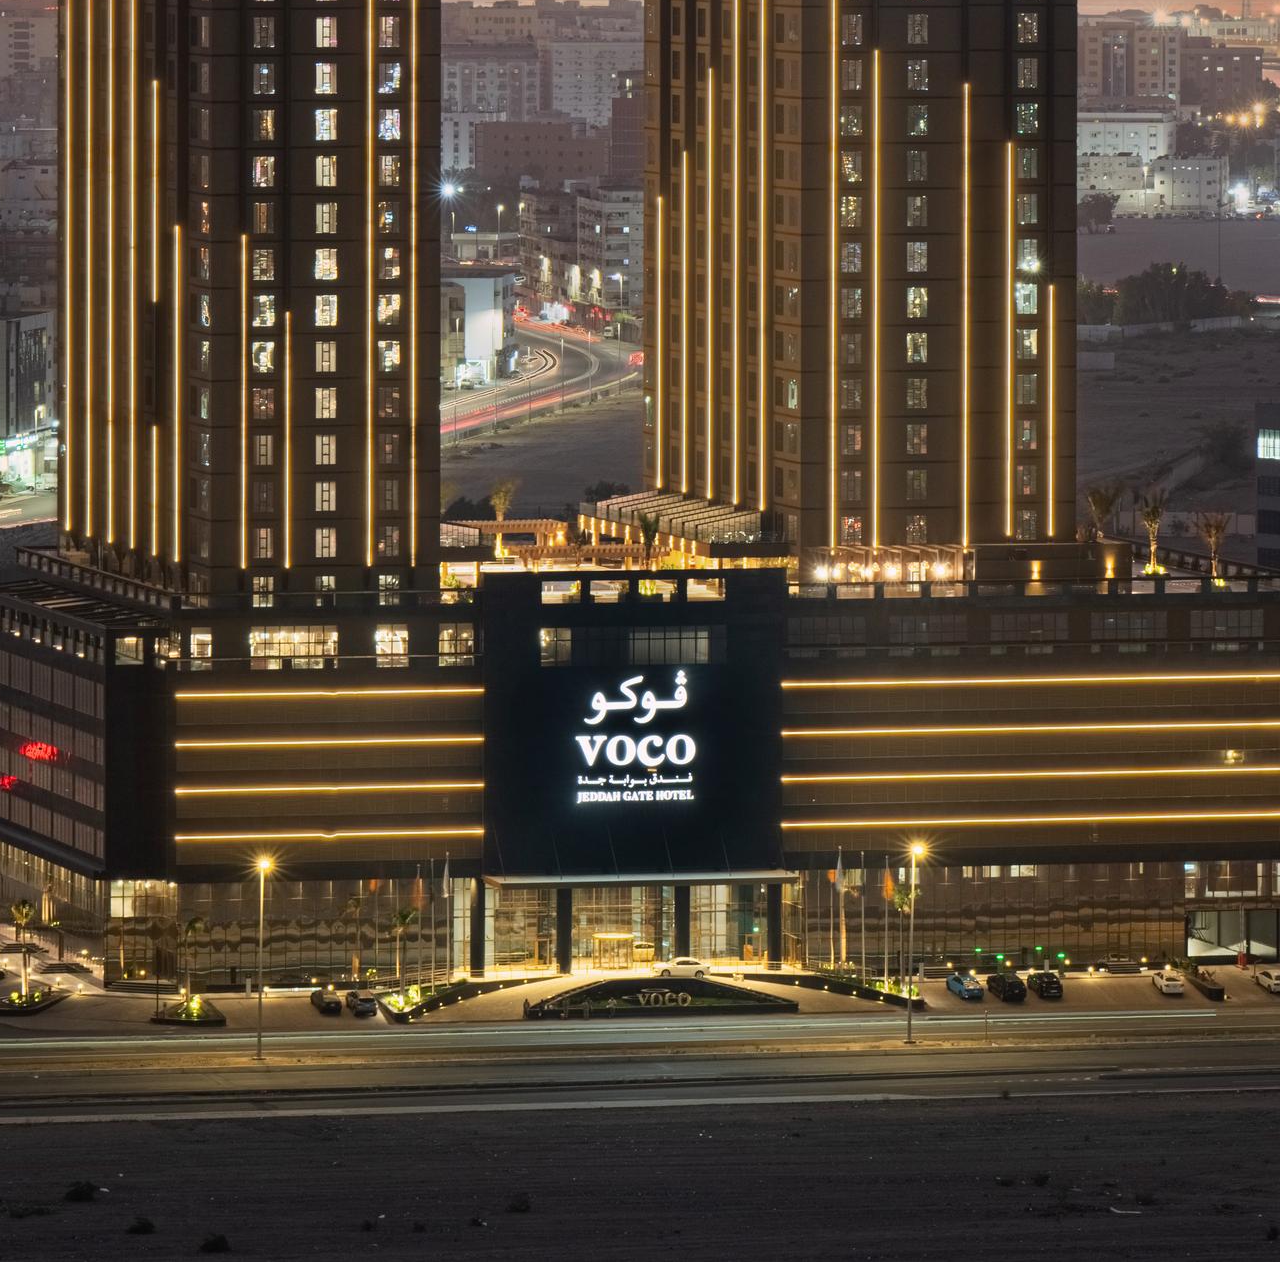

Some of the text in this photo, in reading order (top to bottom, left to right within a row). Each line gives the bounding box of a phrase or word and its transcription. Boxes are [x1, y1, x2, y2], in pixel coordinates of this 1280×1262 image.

[577, 772, 694, 788] فندق بوابة جدة
[576, 790, 695, 804] JEDDAH GATE HOTEL
